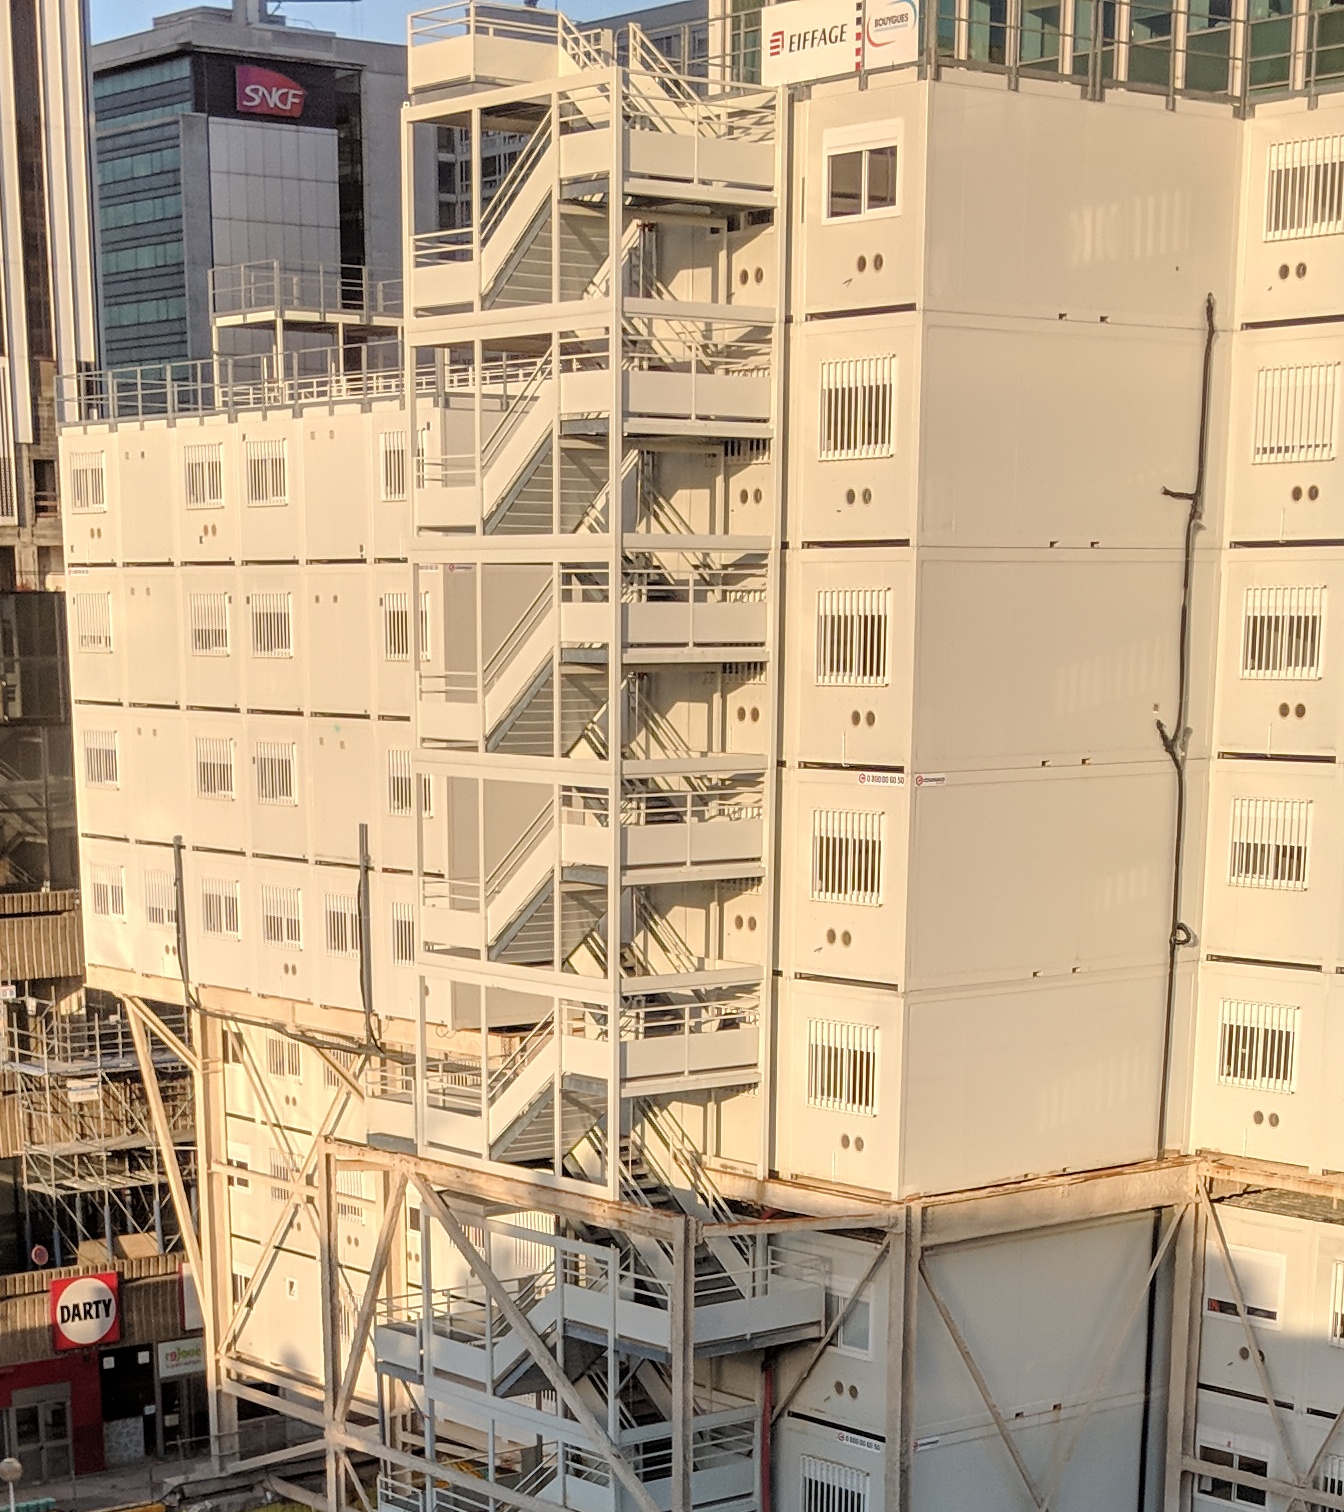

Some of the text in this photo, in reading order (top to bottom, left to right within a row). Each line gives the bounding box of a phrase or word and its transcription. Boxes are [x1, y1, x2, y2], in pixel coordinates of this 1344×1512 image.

[874, 13, 909, 28] BOUYGUES
[789, 24, 848, 53] EIFFAGE
[242, 84, 303, 110] SNCF
[59, 1298, 113, 1325] DARTY
